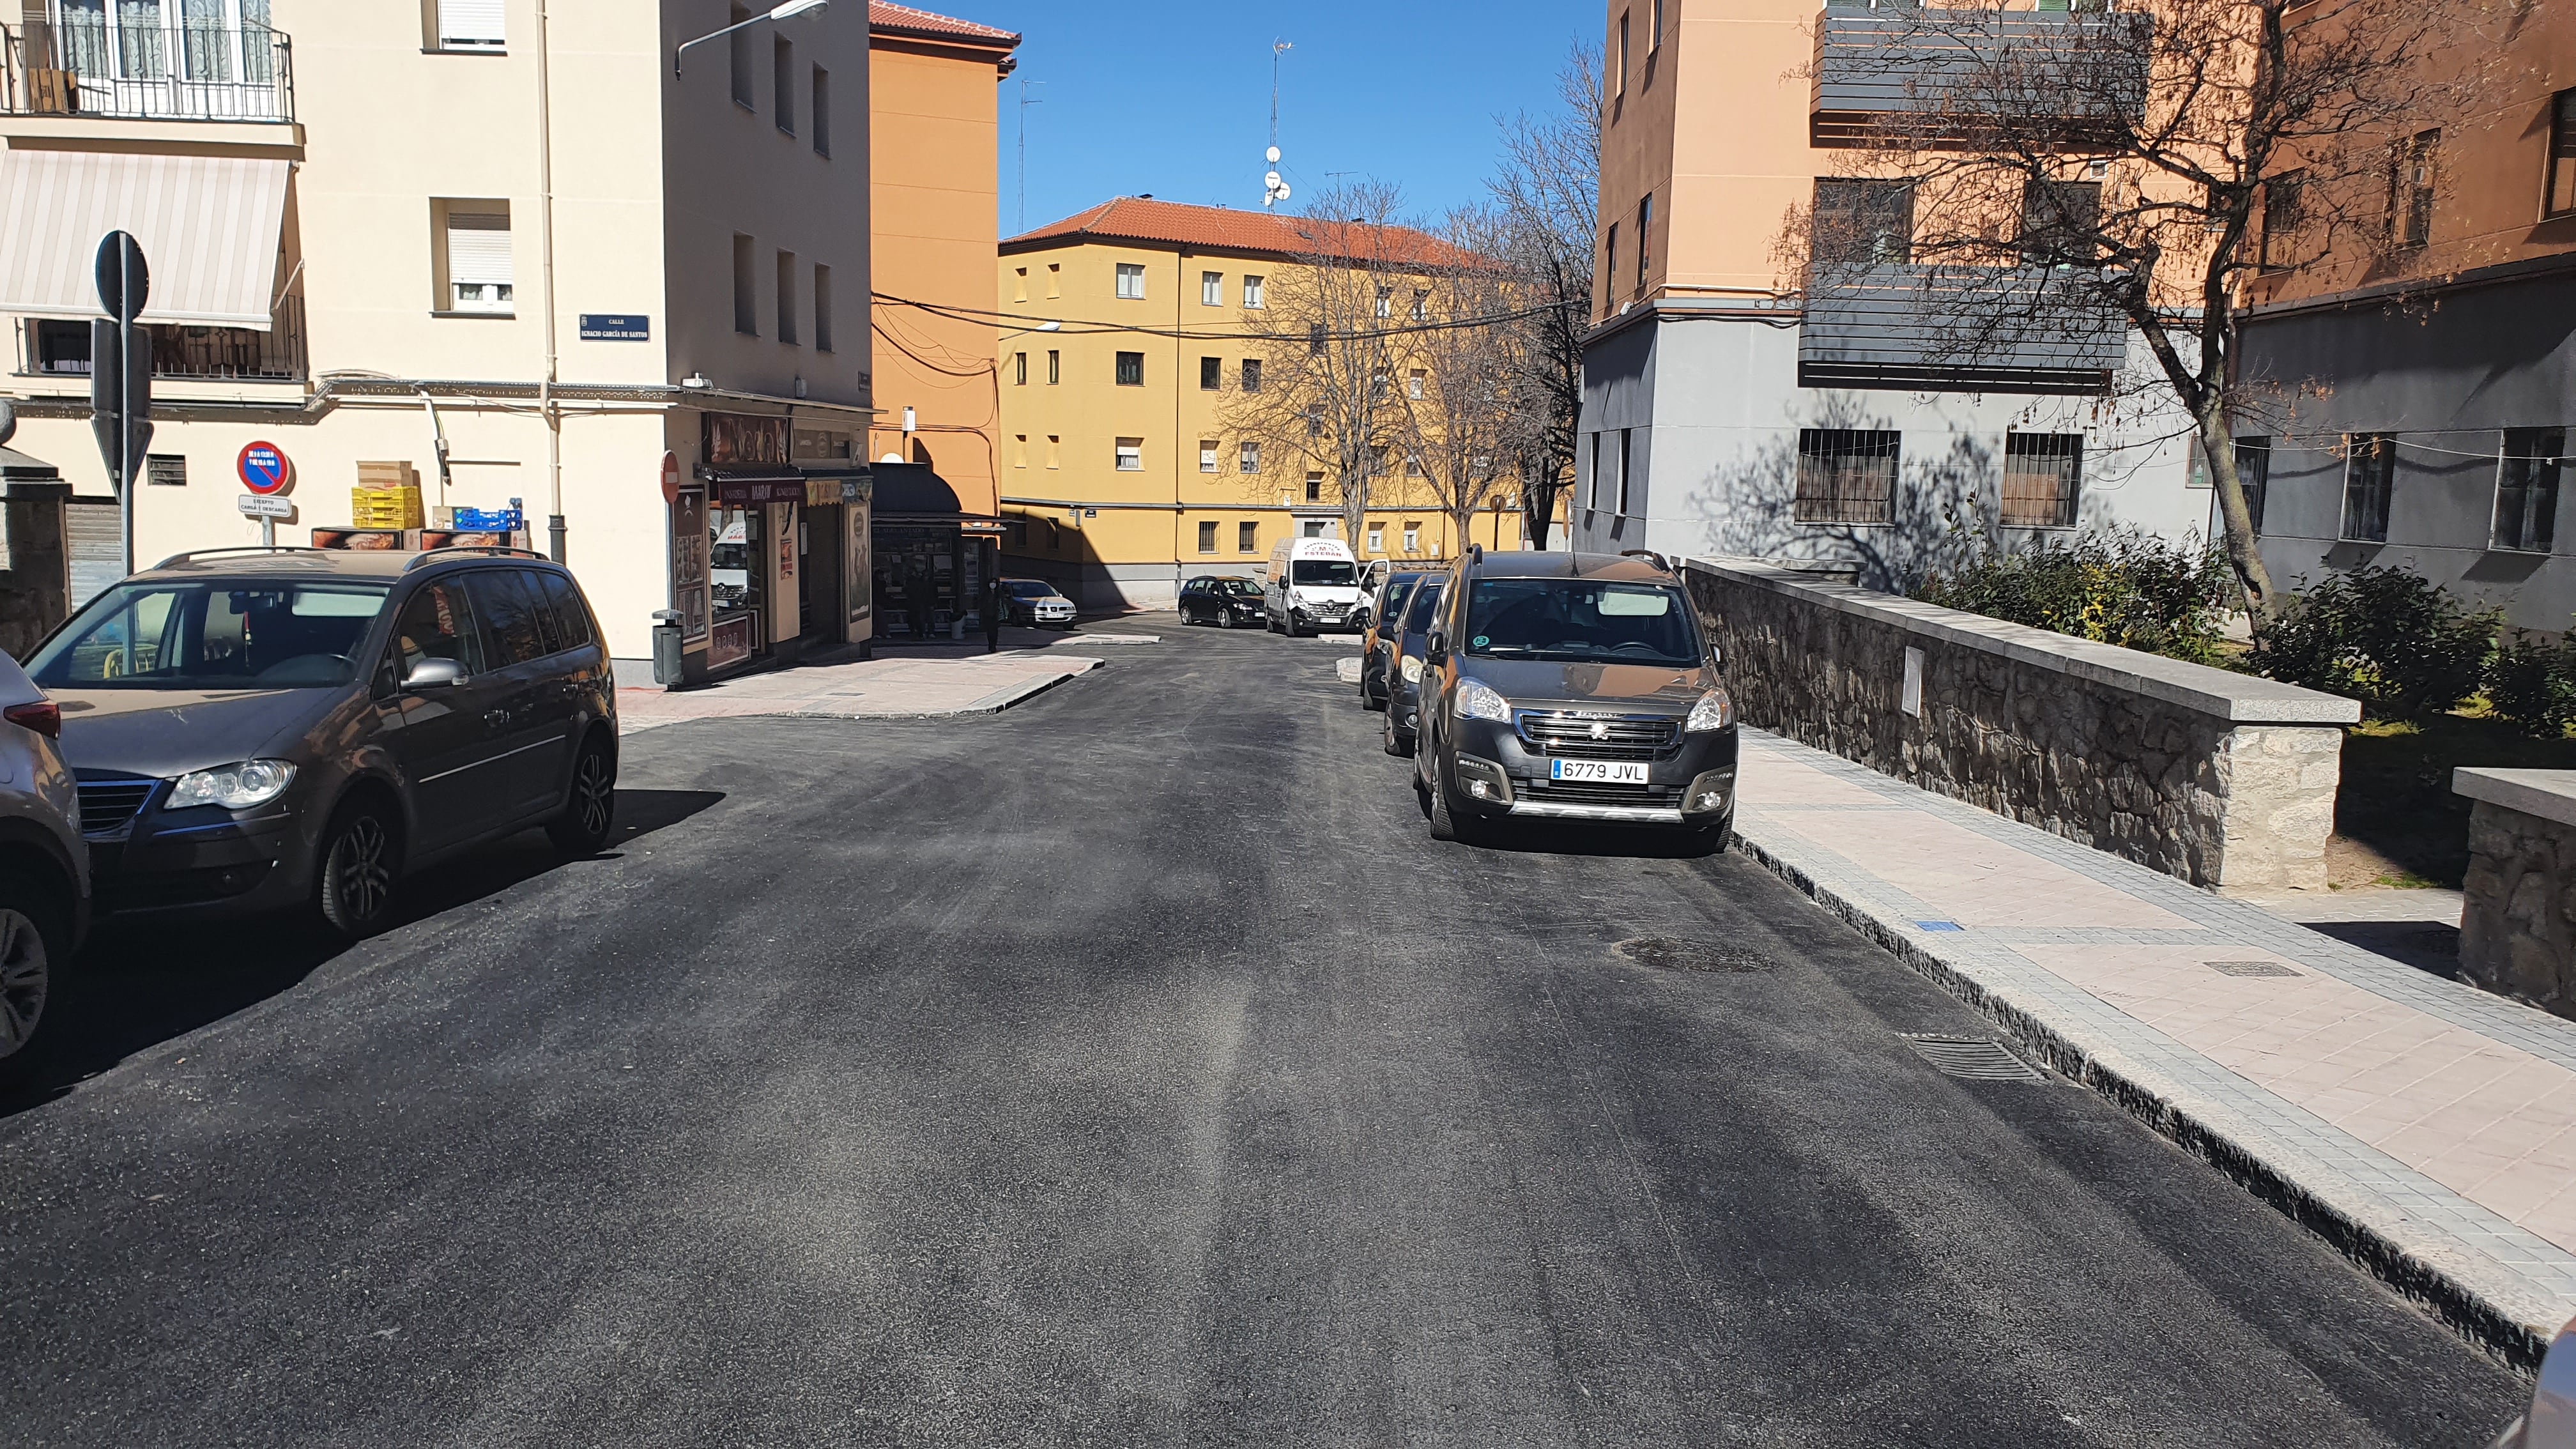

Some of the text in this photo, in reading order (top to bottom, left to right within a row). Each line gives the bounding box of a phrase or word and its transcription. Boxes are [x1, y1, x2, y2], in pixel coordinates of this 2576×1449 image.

[602, 330, 620, 338] GARCÍA
[1564, 762, 1644, 781] 6779 JVL
